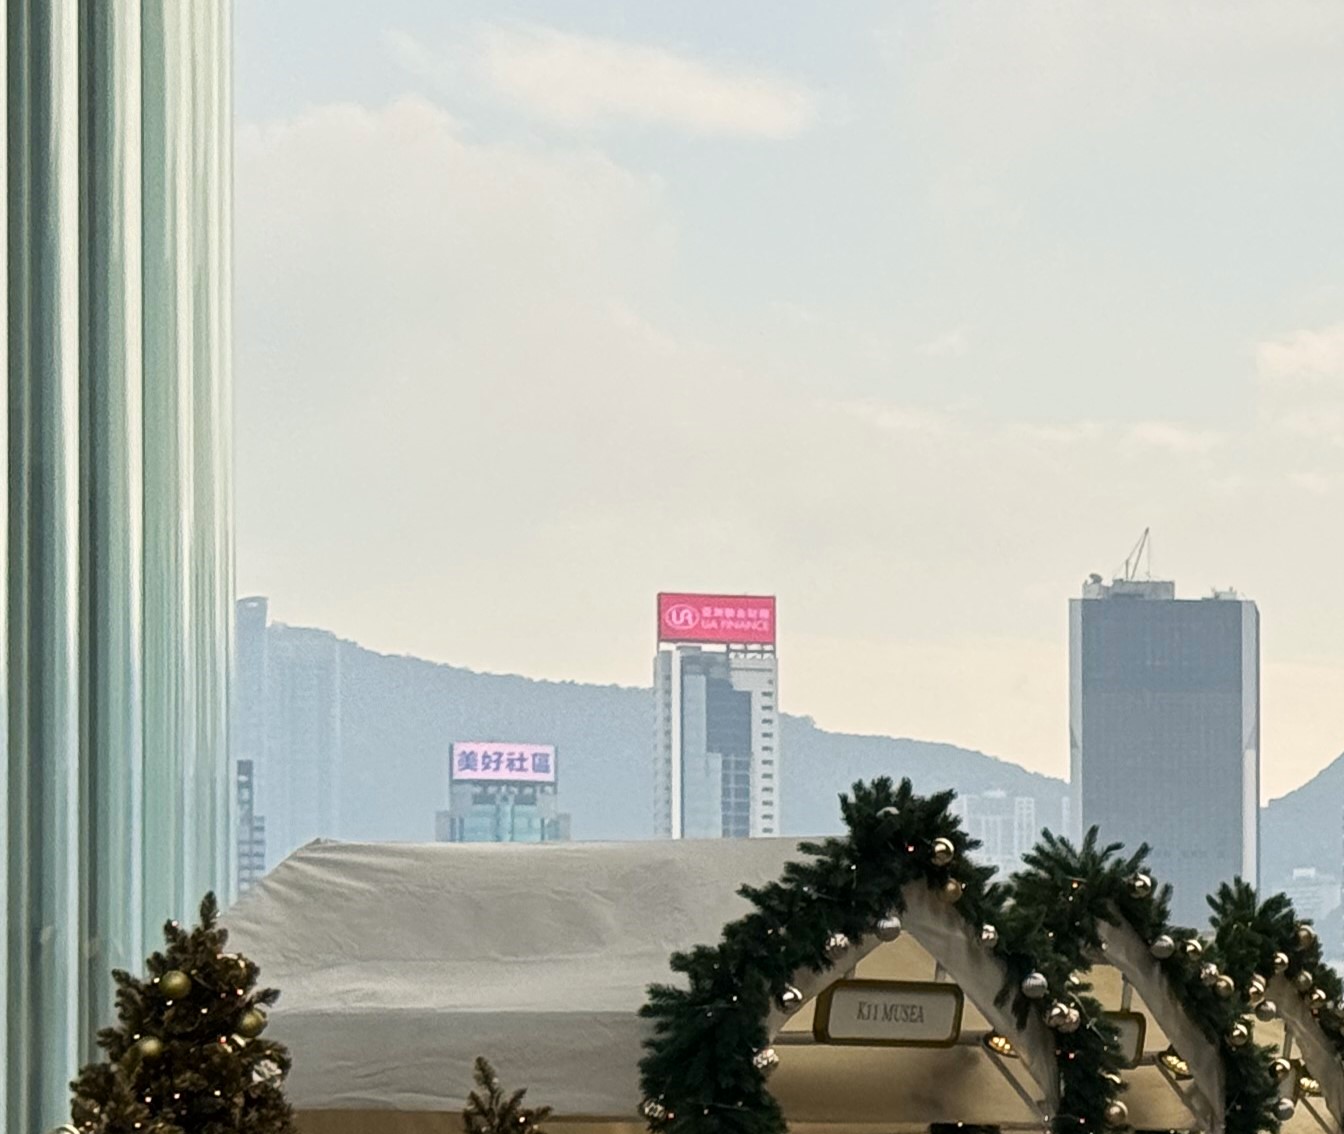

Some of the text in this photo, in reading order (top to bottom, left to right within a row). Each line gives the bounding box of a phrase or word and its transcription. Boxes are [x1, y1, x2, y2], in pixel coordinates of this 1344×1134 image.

[457, 750, 551, 773] 美好社區
[857, 1001, 925, 1024] K11 MUSEA
